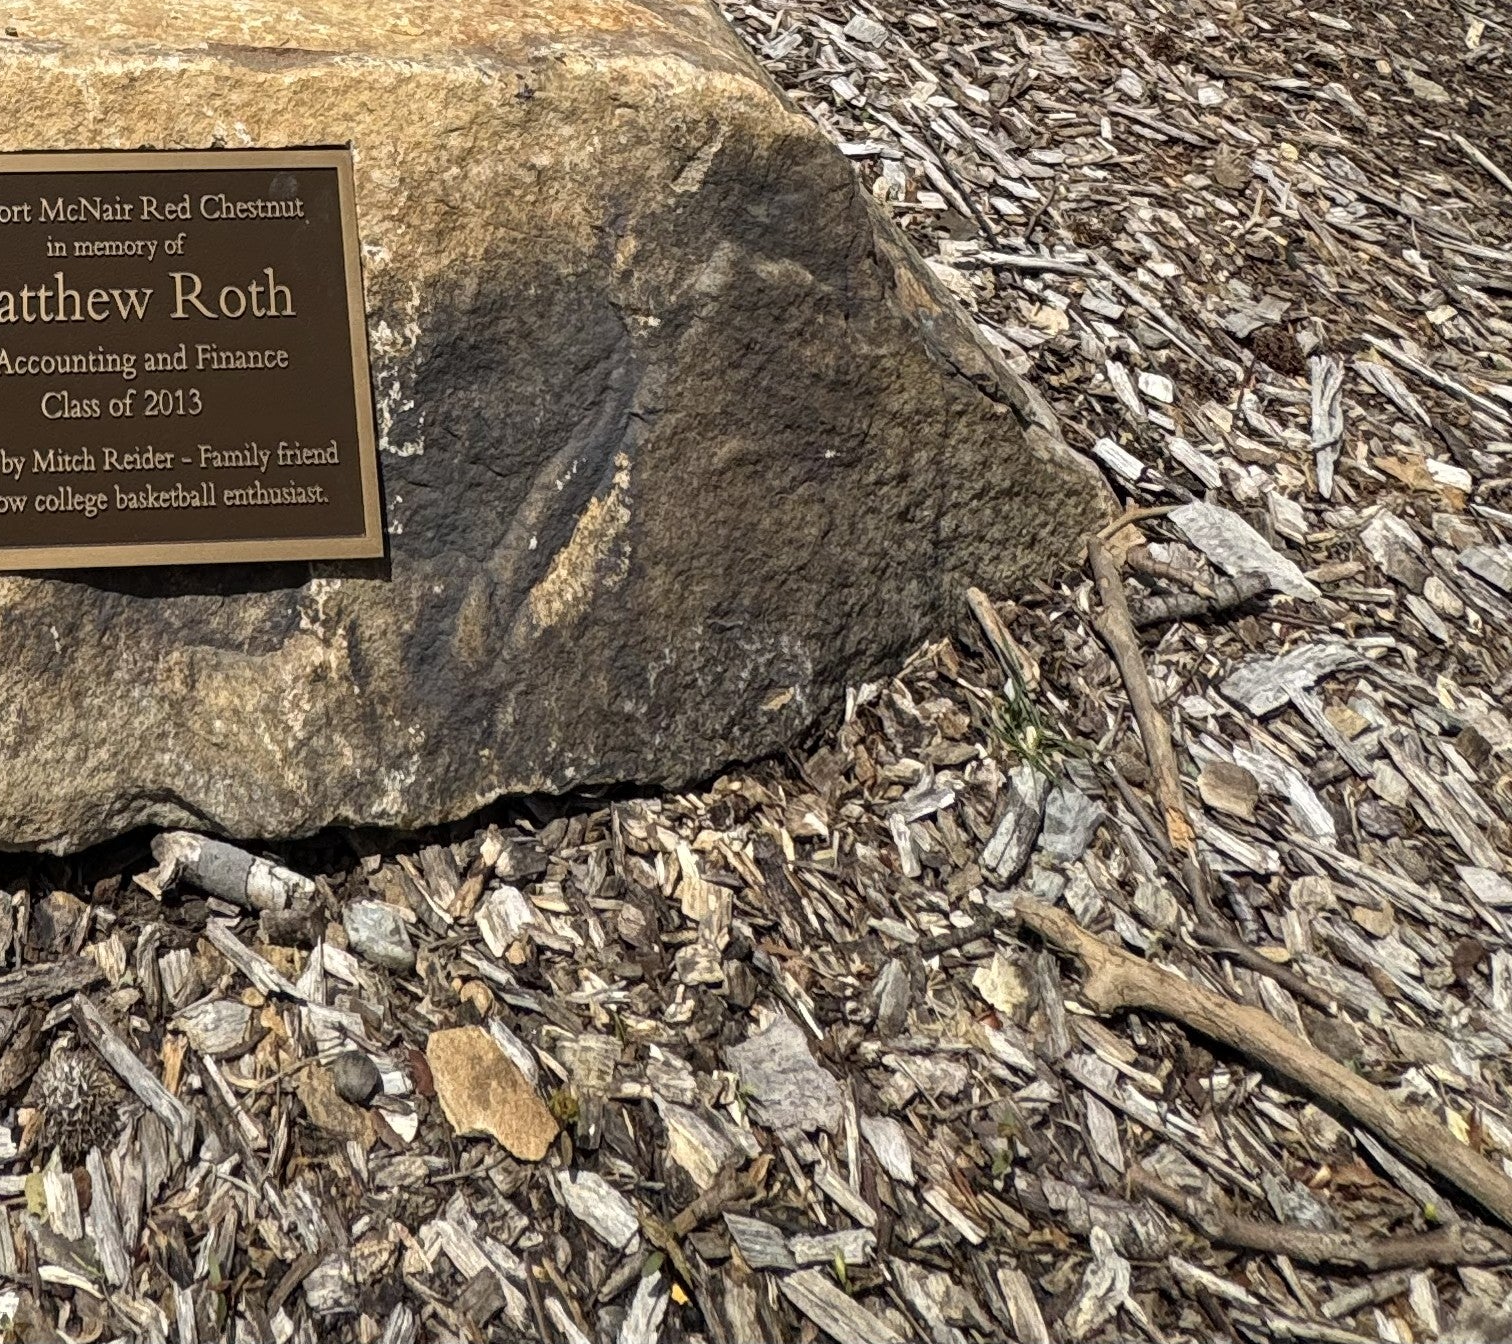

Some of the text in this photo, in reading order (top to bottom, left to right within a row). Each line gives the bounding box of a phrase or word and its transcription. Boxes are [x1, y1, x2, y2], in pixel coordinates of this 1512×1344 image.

[38, 195, 134, 222] McNair
[139, 194, 192, 220] Red
[199, 193, 305, 219] Chestnut
[46, 232, 187, 261] in memory of
[168, 266, 297, 319] Roth
[144, 342, 188, 371] and
[195, 342, 289, 370] Finance
[40, 387, 203, 419] Class of 2013
[0, 448, 26, 481] by
[31, 446, 96, 473] Mitch
[102, 444, 175, 471] Reider
[197, 442, 272, 471] Family
[276, 439, 340, 466] friend
[34, 483, 109, 518] college
[113, 479, 217, 510] basketball
[223, 479, 330, 507] enthusiast.
